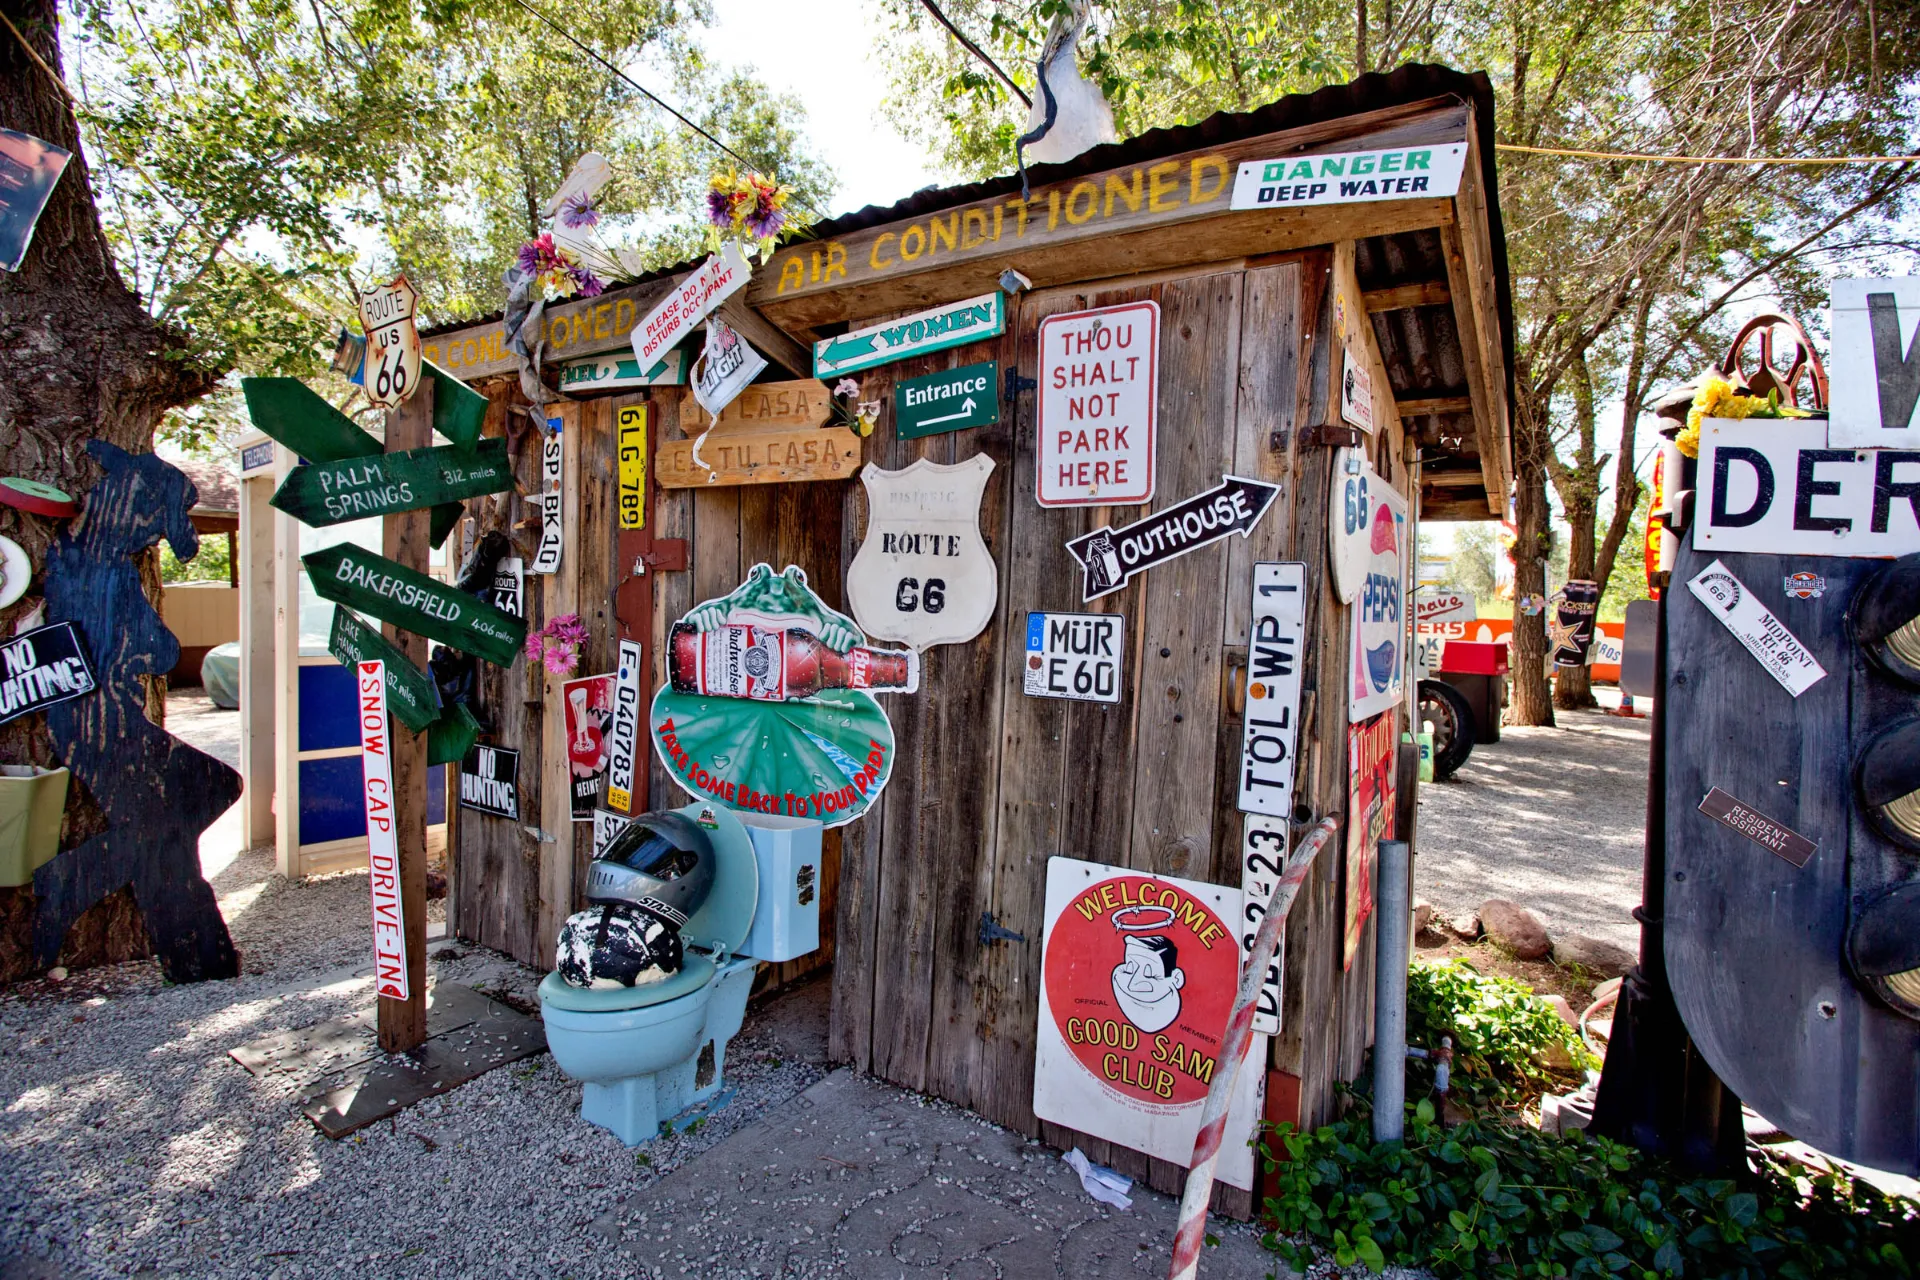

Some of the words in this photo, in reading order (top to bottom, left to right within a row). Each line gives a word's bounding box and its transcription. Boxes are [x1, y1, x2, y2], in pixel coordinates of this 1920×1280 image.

[1261, 150, 1432, 183] DANGER
[1257, 183, 1327, 203] DEEP
[1339, 176, 1429, 197] WATER
[777, 243, 848, 295] AIR
[868, 154, 1230, 270] CONDITIONED
[365, 290, 404, 321] ROUTE
[646, 299, 680, 337] PLEASE
[683, 285, 698, 304] DO
[700, 261, 722, 287] NT
[379, 329, 400, 348] US
[446, 298, 638, 369] CONDIONED
[642, 317, 681, 358] DISTURB
[880, 302, 993, 348] WOMEN
[1061, 324, 1132, 356] THOU
[376, 350, 406, 399] 66
[563, 363, 606, 384] MEN
[704, 344, 744, 397] LIGHT
[1052, 356, 1140, 390] SHALT
[739, 390, 811, 420] CASA
[905, 376, 987, 407] Entrance
[1069, 392, 1120, 421] NOT
[717, 446, 751, 470] TU
[767, 438, 838, 467] CASA
[1058, 425, 1130, 454] PARK
[545, 443, 560, 476] SP
[1059, 459, 1129, 487] HERE
[319, 463, 385, 494] PALM
[444, 469, 467, 485] 312
[469, 467, 497, 481] miles
[1710, 446, 1920, 533] DER
[324, 482, 414, 519] SPRINGS
[544, 495, 559, 528] BK
[1345, 475, 1368, 536] 66
[881, 532, 961, 557] ROUTE
[1120, 489, 1253, 565] OUTHOUSE
[335, 557, 461, 622] BAKERSFIELD
[471, 619, 495, 637] 406
[495, 630, 515, 645] miles
[494, 577, 516, 589] ROUTE
[895, 577, 946, 614] 66
[1363, 570, 1399, 624] PEPSI
[1709, 585, 1726, 601] 66
[339, 614, 360, 642] LAKE
[1031, 636, 1039, 647] D
[2, 638, 37, 679] NO
[622, 648, 637, 669] F
[728, 627, 742, 695] Budweiser
[850, 647, 870, 690] Bud
[1048, 658, 1068, 693] E
[1073, 660, 1115, 696] 60
[1770, 657, 1791, 679] TEXAS
[1776, 651, 1793, 666] 66
[334, 648, 351, 668] CITY
[386, 670, 397, 690] 132
[398, 685, 416, 707] miles
[361, 678, 385, 756] SNOW
[612, 686, 636, 791] 040783
[478, 748, 496, 780] NO
[657, 717, 690, 772] TAKE
[687, 761, 734, 802] SOME
[736, 785, 782, 816] BACK
[783, 793, 808, 818] TO
[808, 784, 860, 817] YOUR
[852, 740, 887, 796] PAD!
[367, 778, 390, 833] CAP
[461, 772, 514, 812] HUNTING
[1722, 812, 1787, 851] ASSISTANT
[1731, 805, 1790, 842] RESIDENT
[371, 855, 402, 982] DRIVE-IN
[639, 896, 674, 915] STAR
[1074, 882, 1226, 951] WELCOME
[1073, 998, 1109, 1007] OFFICIAL
[1066, 1016, 1140, 1052] GOOD
[1151, 1033, 1217, 1086] SAM
[1179, 1023, 1217, 1046] MEMBER
[1101, 1053, 1176, 1100] CLUB
[1101, 1089, 1126, 1107] TRAILER
